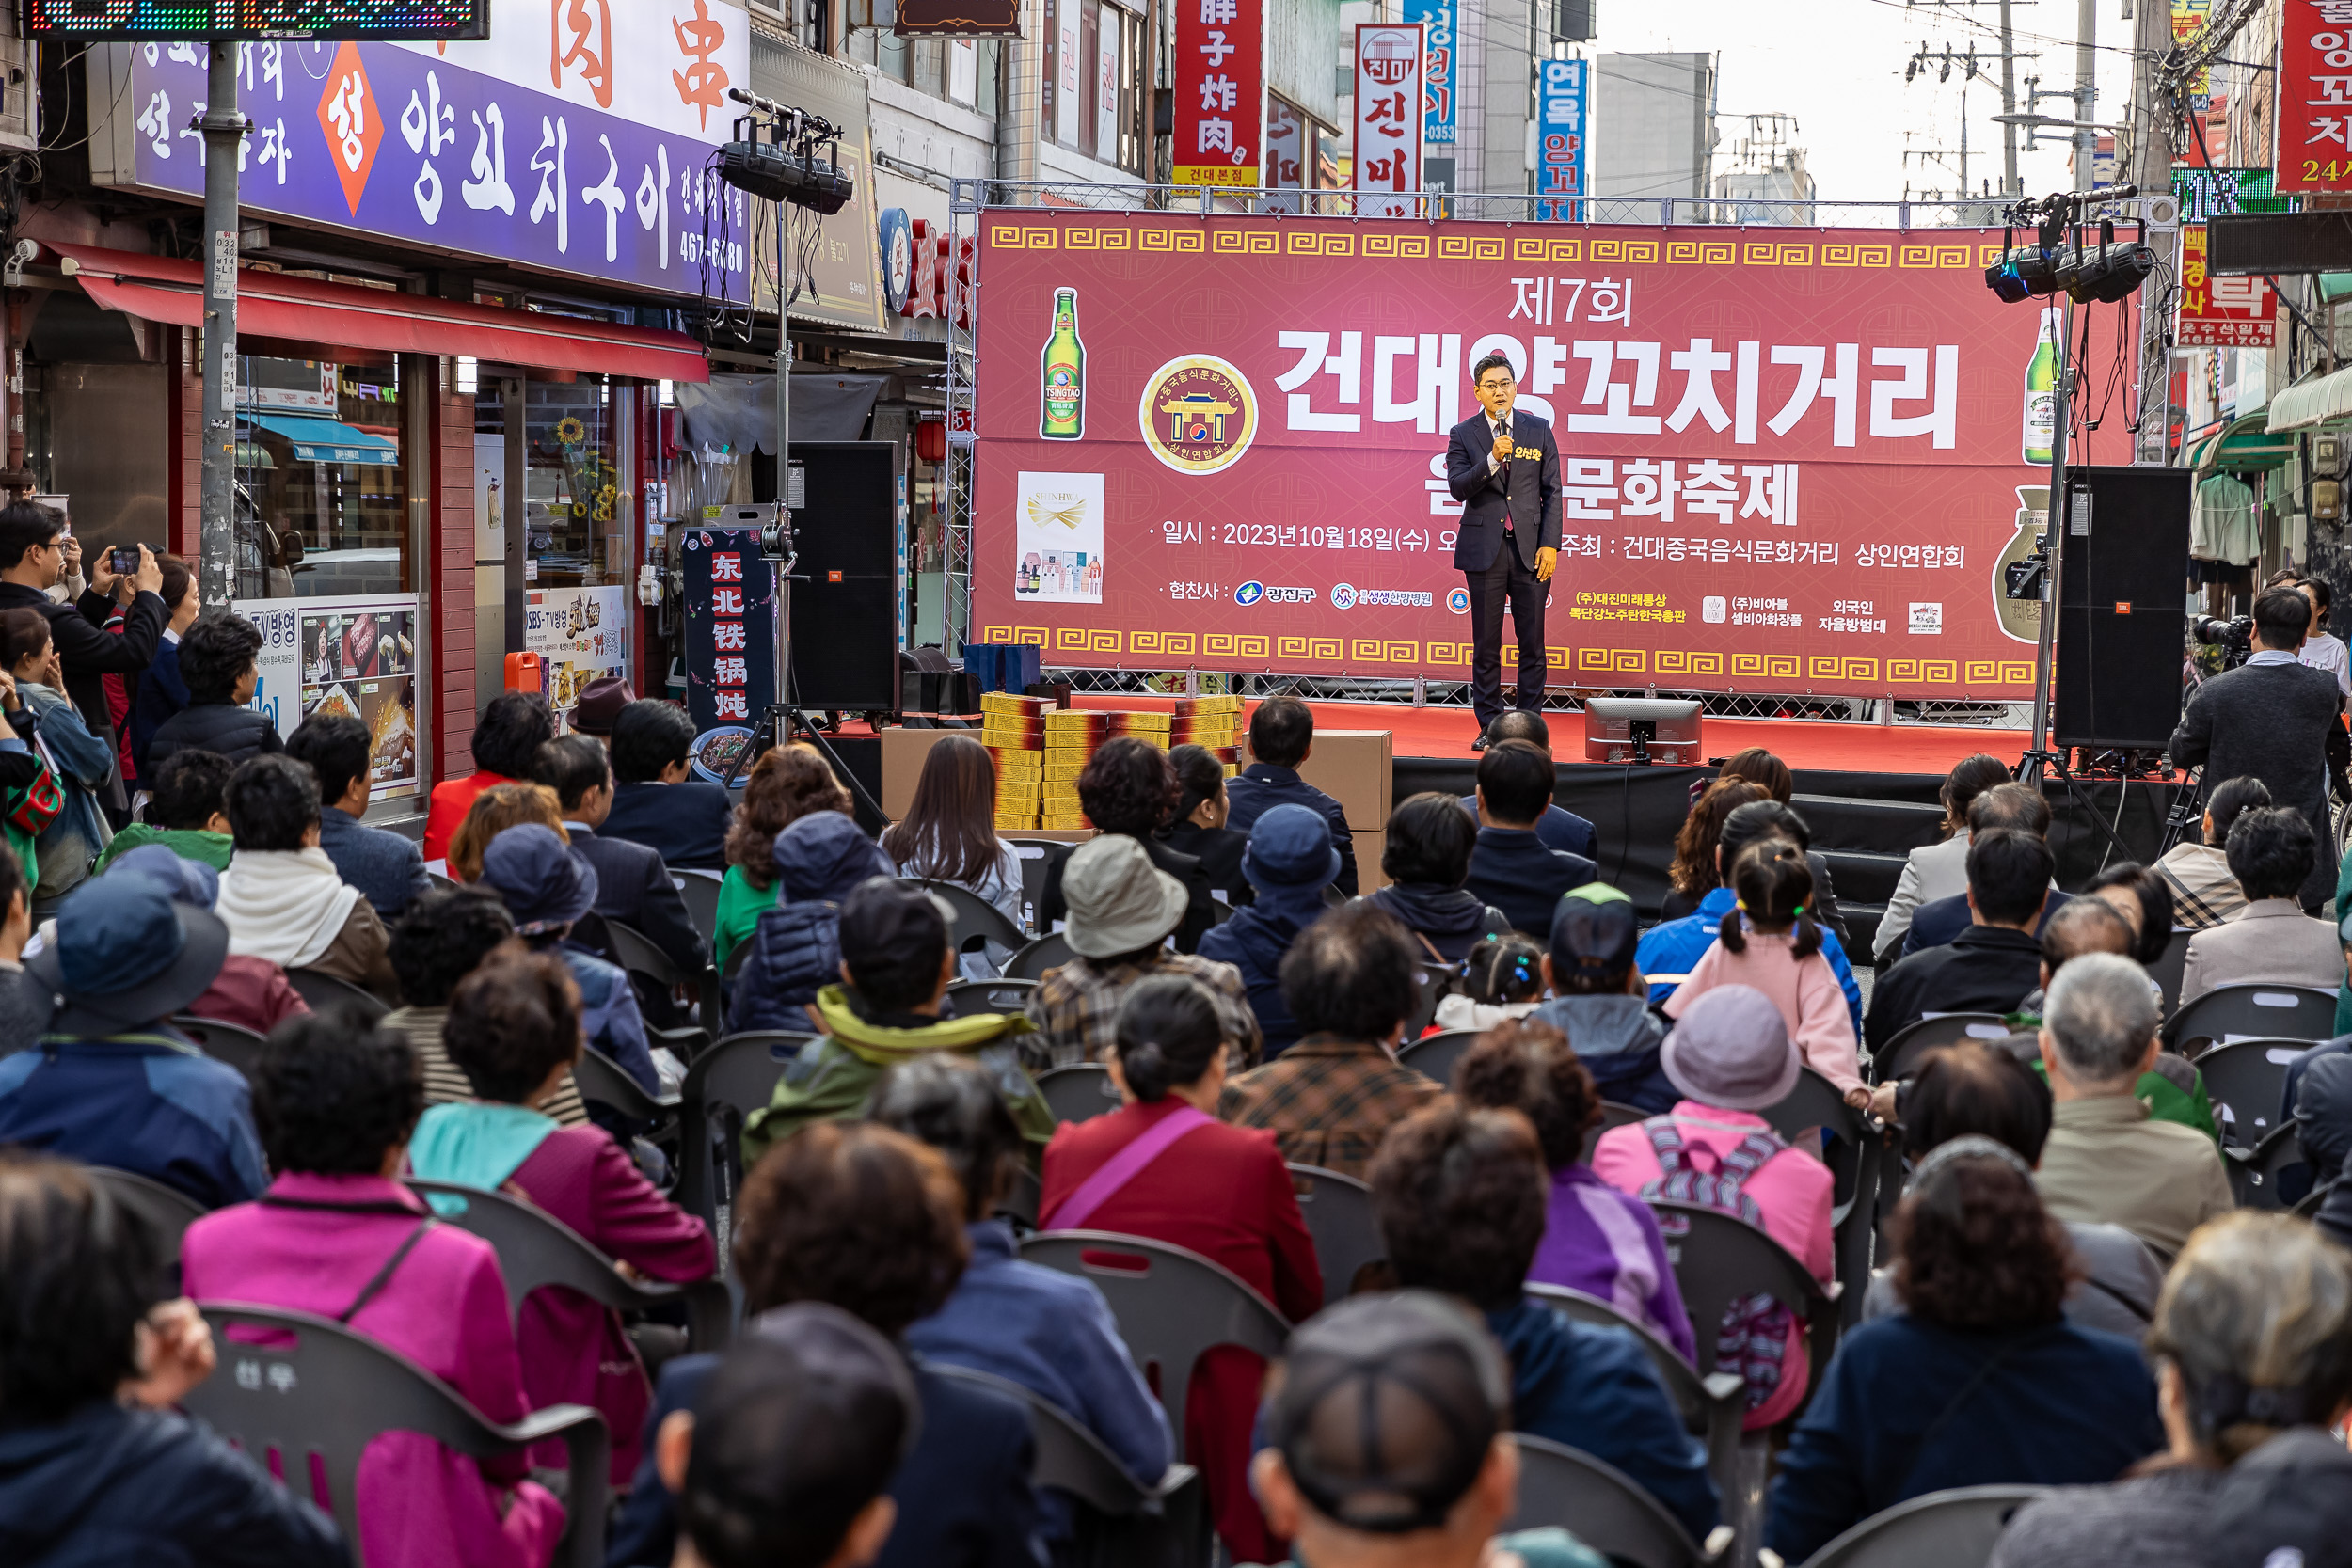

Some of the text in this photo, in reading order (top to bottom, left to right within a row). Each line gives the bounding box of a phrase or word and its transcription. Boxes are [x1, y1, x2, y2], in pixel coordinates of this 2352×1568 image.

[550, 0, 730, 134] 肉串
[1369, 60, 1410, 81] 진미
[327, 70, 365, 173] 성
[1364, 91, 1407, 217] 진미
[400, 70, 671, 270] 양꼬치구이
[1189, 168, 1242, 182] 건대본점
[1508, 277, 1632, 328] 제7회
[2179, 334, 2273, 346] 465-1704
[1045, 388, 1081, 398] TSINGTAO
[1160, 368, 1239, 400] 중국음식문화거리
[1274, 329, 1960, 450] 건대양꼬치거리
[1169, 443, 1224, 461] 상인연합회
[1162, 520, 1203, 545] 일시
[1223, 523, 1431, 553] 2023년10월18일(수)
[1561, 534, 1602, 559] 주최
[1623, 535, 1839, 566] 건대중국음식문화거리
[1854, 543, 1965, 569] 상인연합회
[1168, 580, 1219, 601] 협찬사
[1267, 587, 1316, 603] 광진구
[1369, 590, 1432, 606] 생생한방병원
[1576, 591, 1667, 608] (주)대진미래통상
[1731, 596, 1788, 611] (주)비아블
[1832, 599, 1874, 616] 외국인
[1818, 616, 1887, 634] 자율방범대
[710, 554, 750, 720] 东北铁锅炖
